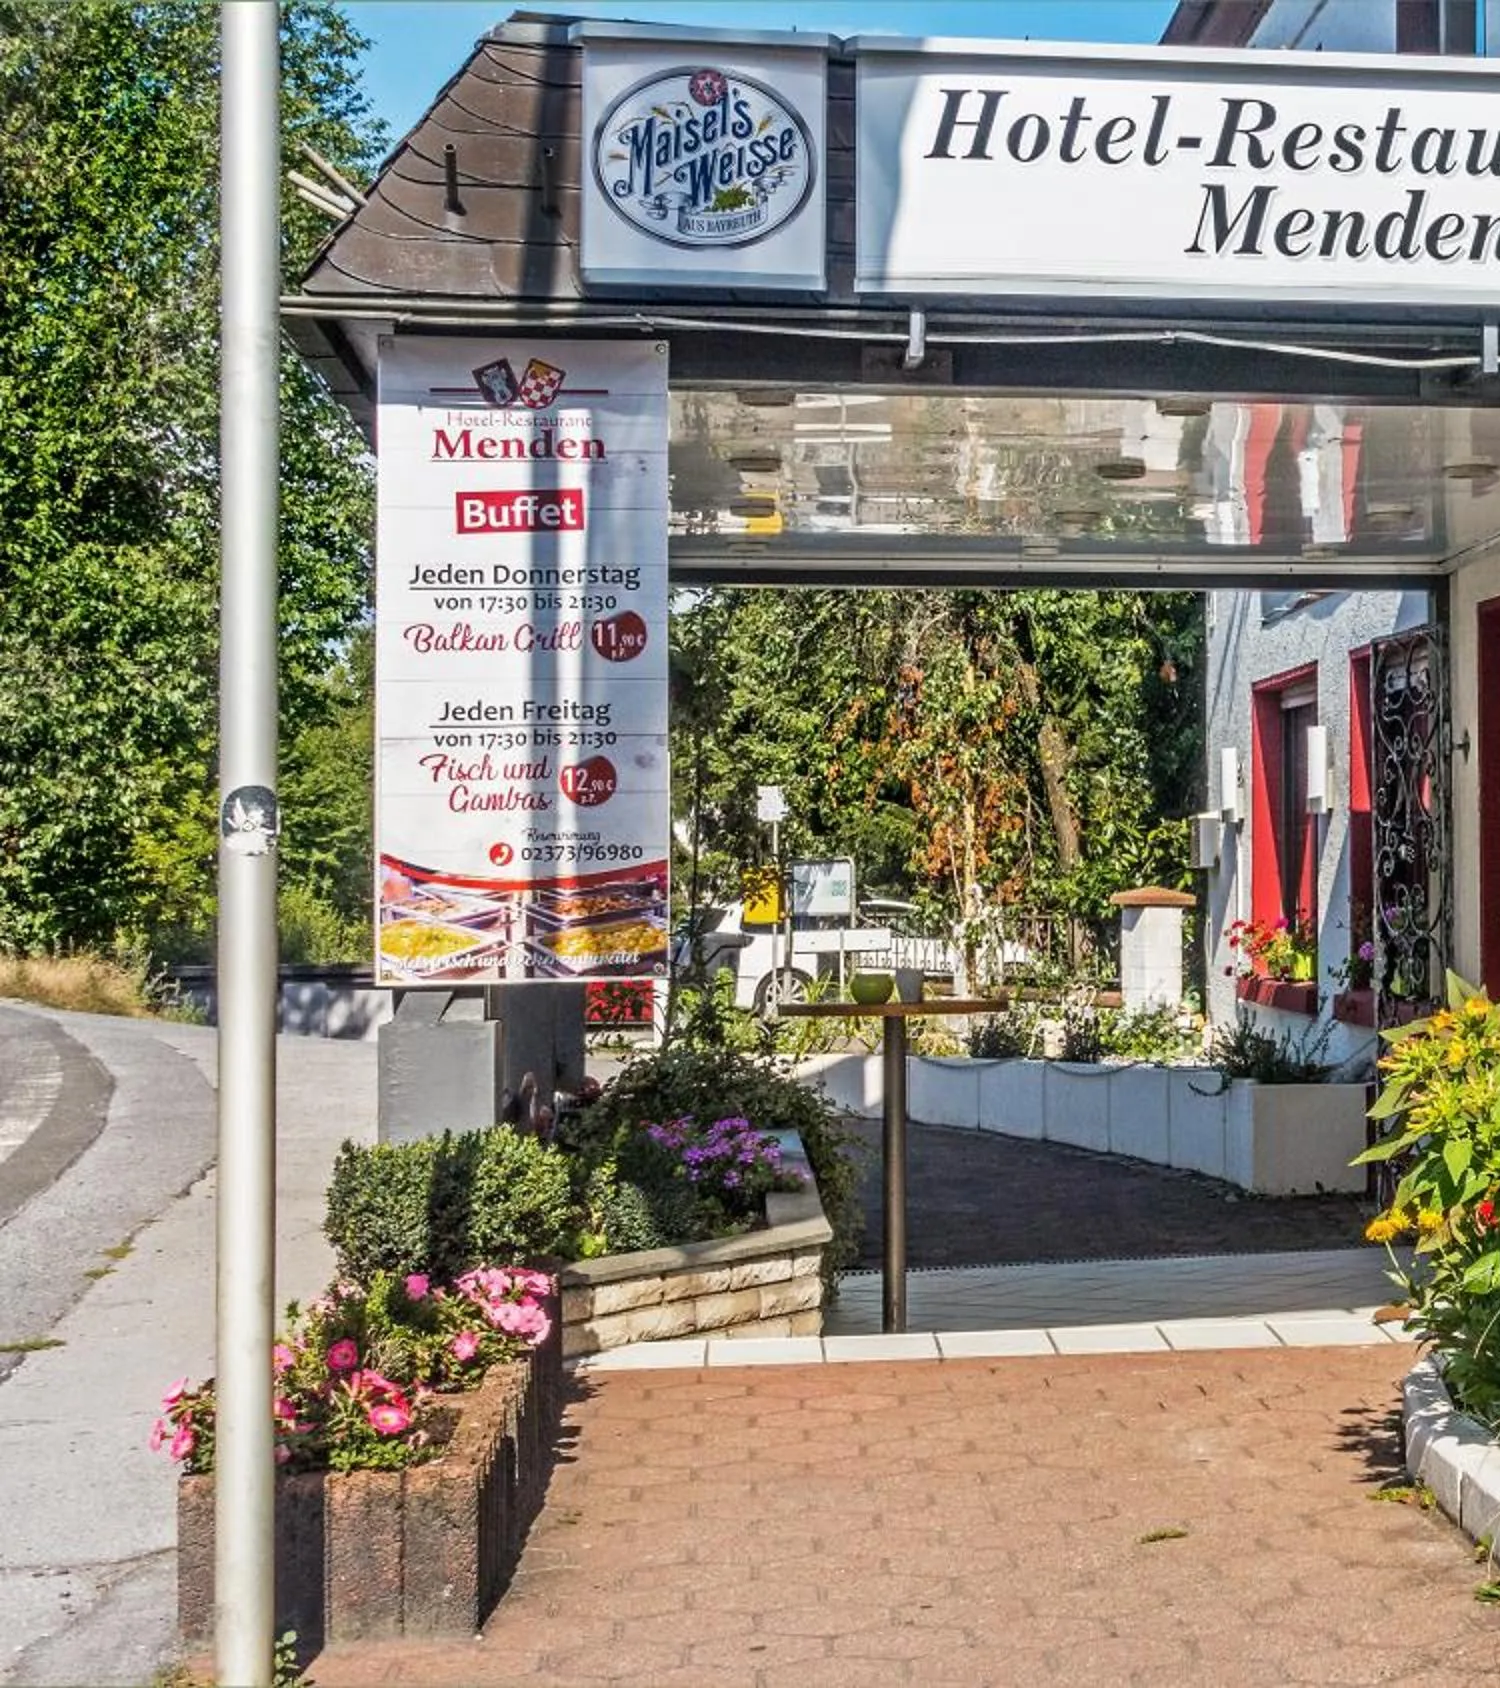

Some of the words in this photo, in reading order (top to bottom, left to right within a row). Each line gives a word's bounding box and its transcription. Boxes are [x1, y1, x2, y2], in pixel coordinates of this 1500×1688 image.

[613, 87, 753, 197] Maisel's
[673, 127, 797, 206] Weisse
[684, 217, 705, 232] AUS
[447, 411, 593, 428] Hotel-Restaurant
[432, 429, 607, 460] Menden
[463, 496, 577, 529] Buffet
[409, 564, 485, 585] Jeden
[493, 565, 641, 591] Donnerstag
[434, 596, 473, 610] von
[479, 595, 528, 614] 17:30
[534, 593, 563, 610] bis
[569, 594, 617, 614] 21:30
[403, 622, 509, 653] Balkan
[513, 622, 584, 653] Grill
[439, 701, 514, 721] Jeden
[522, 701, 612, 726] Freitag
[434, 733, 472, 748] von
[479, 732, 527, 750] 17:30
[533, 730, 562, 746] bis
[568, 732, 617, 749] 21:30
[419, 753, 498, 782] Fisch
[503, 755, 552, 781] und
[449, 784, 553, 813] Gambas
[521, 843, 644, 863] 02373/96980
